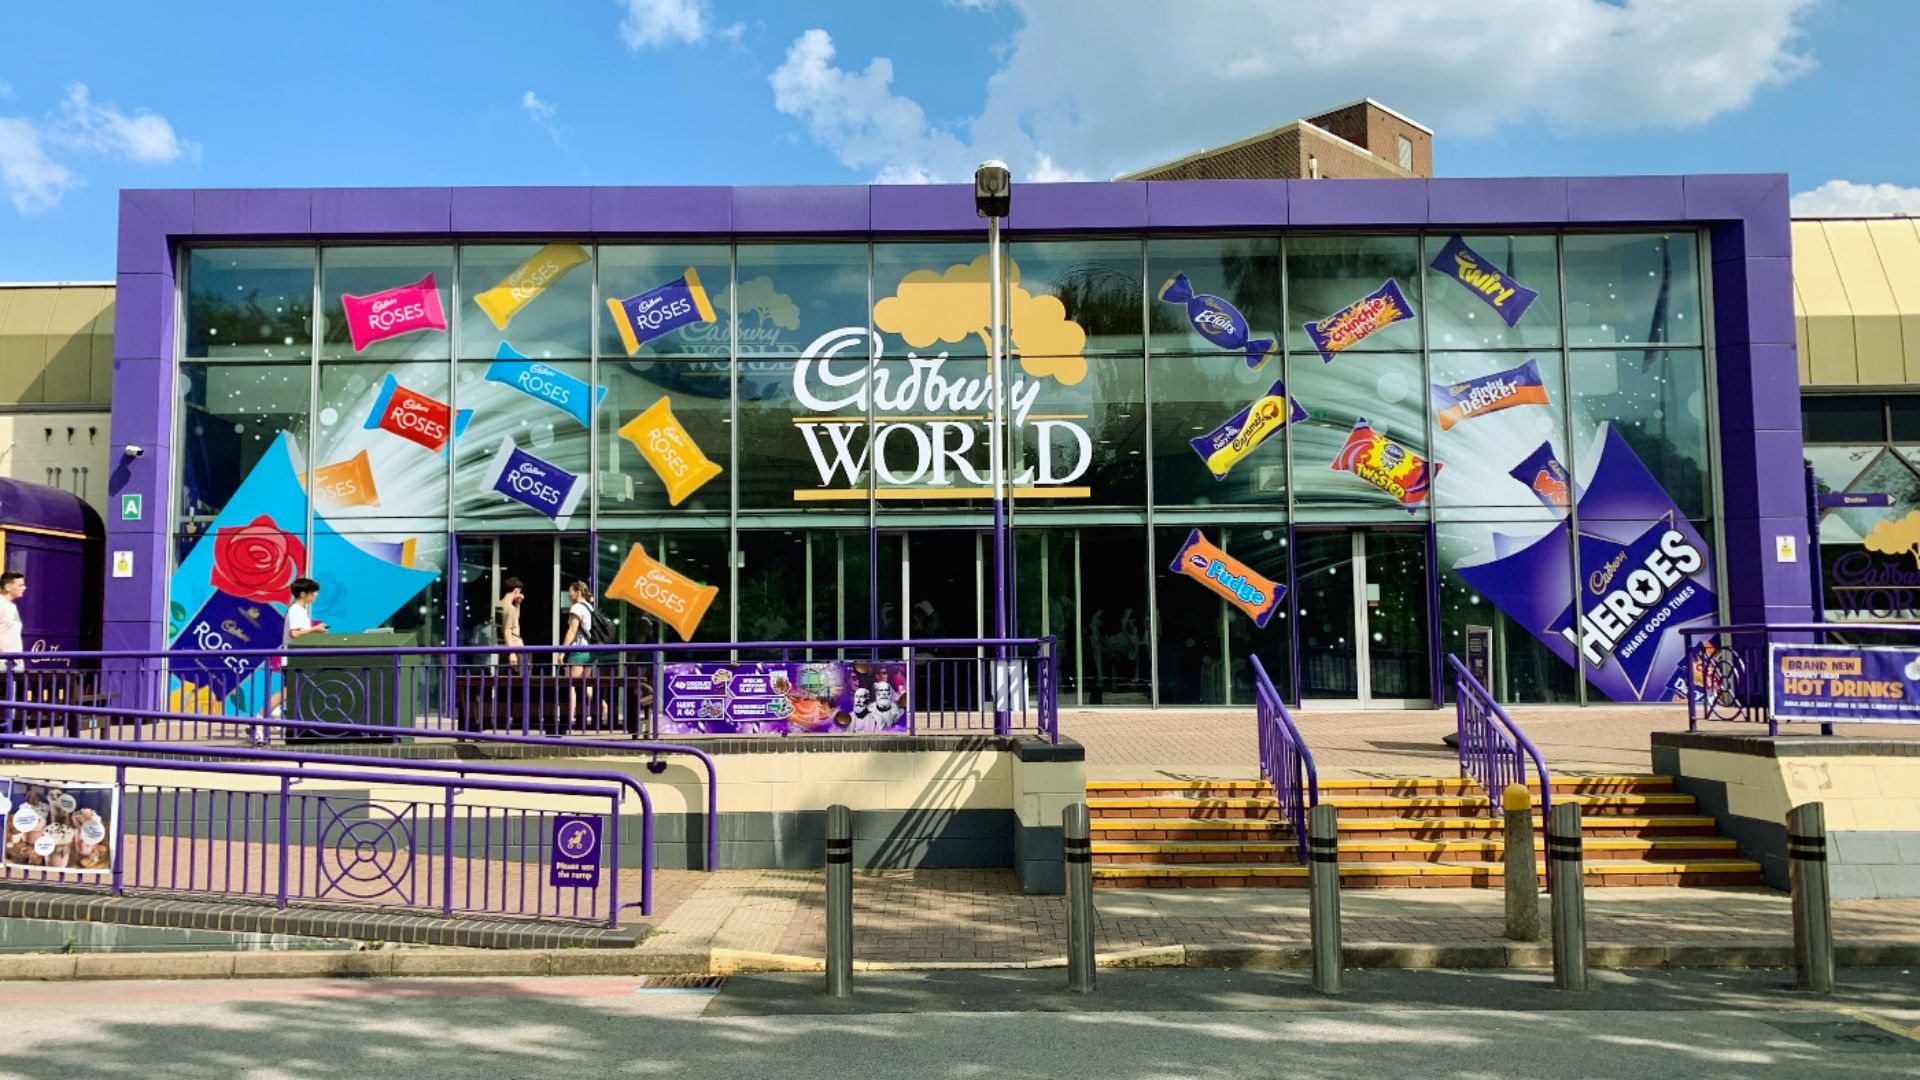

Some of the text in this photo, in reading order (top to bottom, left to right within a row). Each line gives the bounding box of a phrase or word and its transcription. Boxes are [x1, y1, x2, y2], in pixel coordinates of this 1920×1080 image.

[511, 260, 560, 302] ROSES
[1455, 254, 1515, 306] Twirl
[369, 303, 424, 330] ROSES
[637, 298, 691, 330] ROSES
[1331, 298, 1383, 342] crunchie
[1353, 321, 1377, 340] bits
[518, 371, 570, 404] ROSES
[1458, 380, 1518, 415] Decker
[390, 407, 445, 439] ROSES
[647, 428, 689, 477] ROSES
[794, 421, 1093, 487] WORLD
[507, 470, 561, 504] ROSES
[125, 501, 138, 515] A
[1206, 560, 1265, 605] Fudge
[1589, 551, 1628, 595] Cadbury
[634, 576, 686, 614] ROSES
[1562, 530, 1702, 667] HEROES
[1621, 586, 1695, 659] SHARE GOOD TIMES
[1788, 660, 1855, 671] BRAND NEW
[1784, 678, 1904, 698] HOT DRINKS
[557, 862, 579, 870] Please
[558, 870, 569, 878] the
